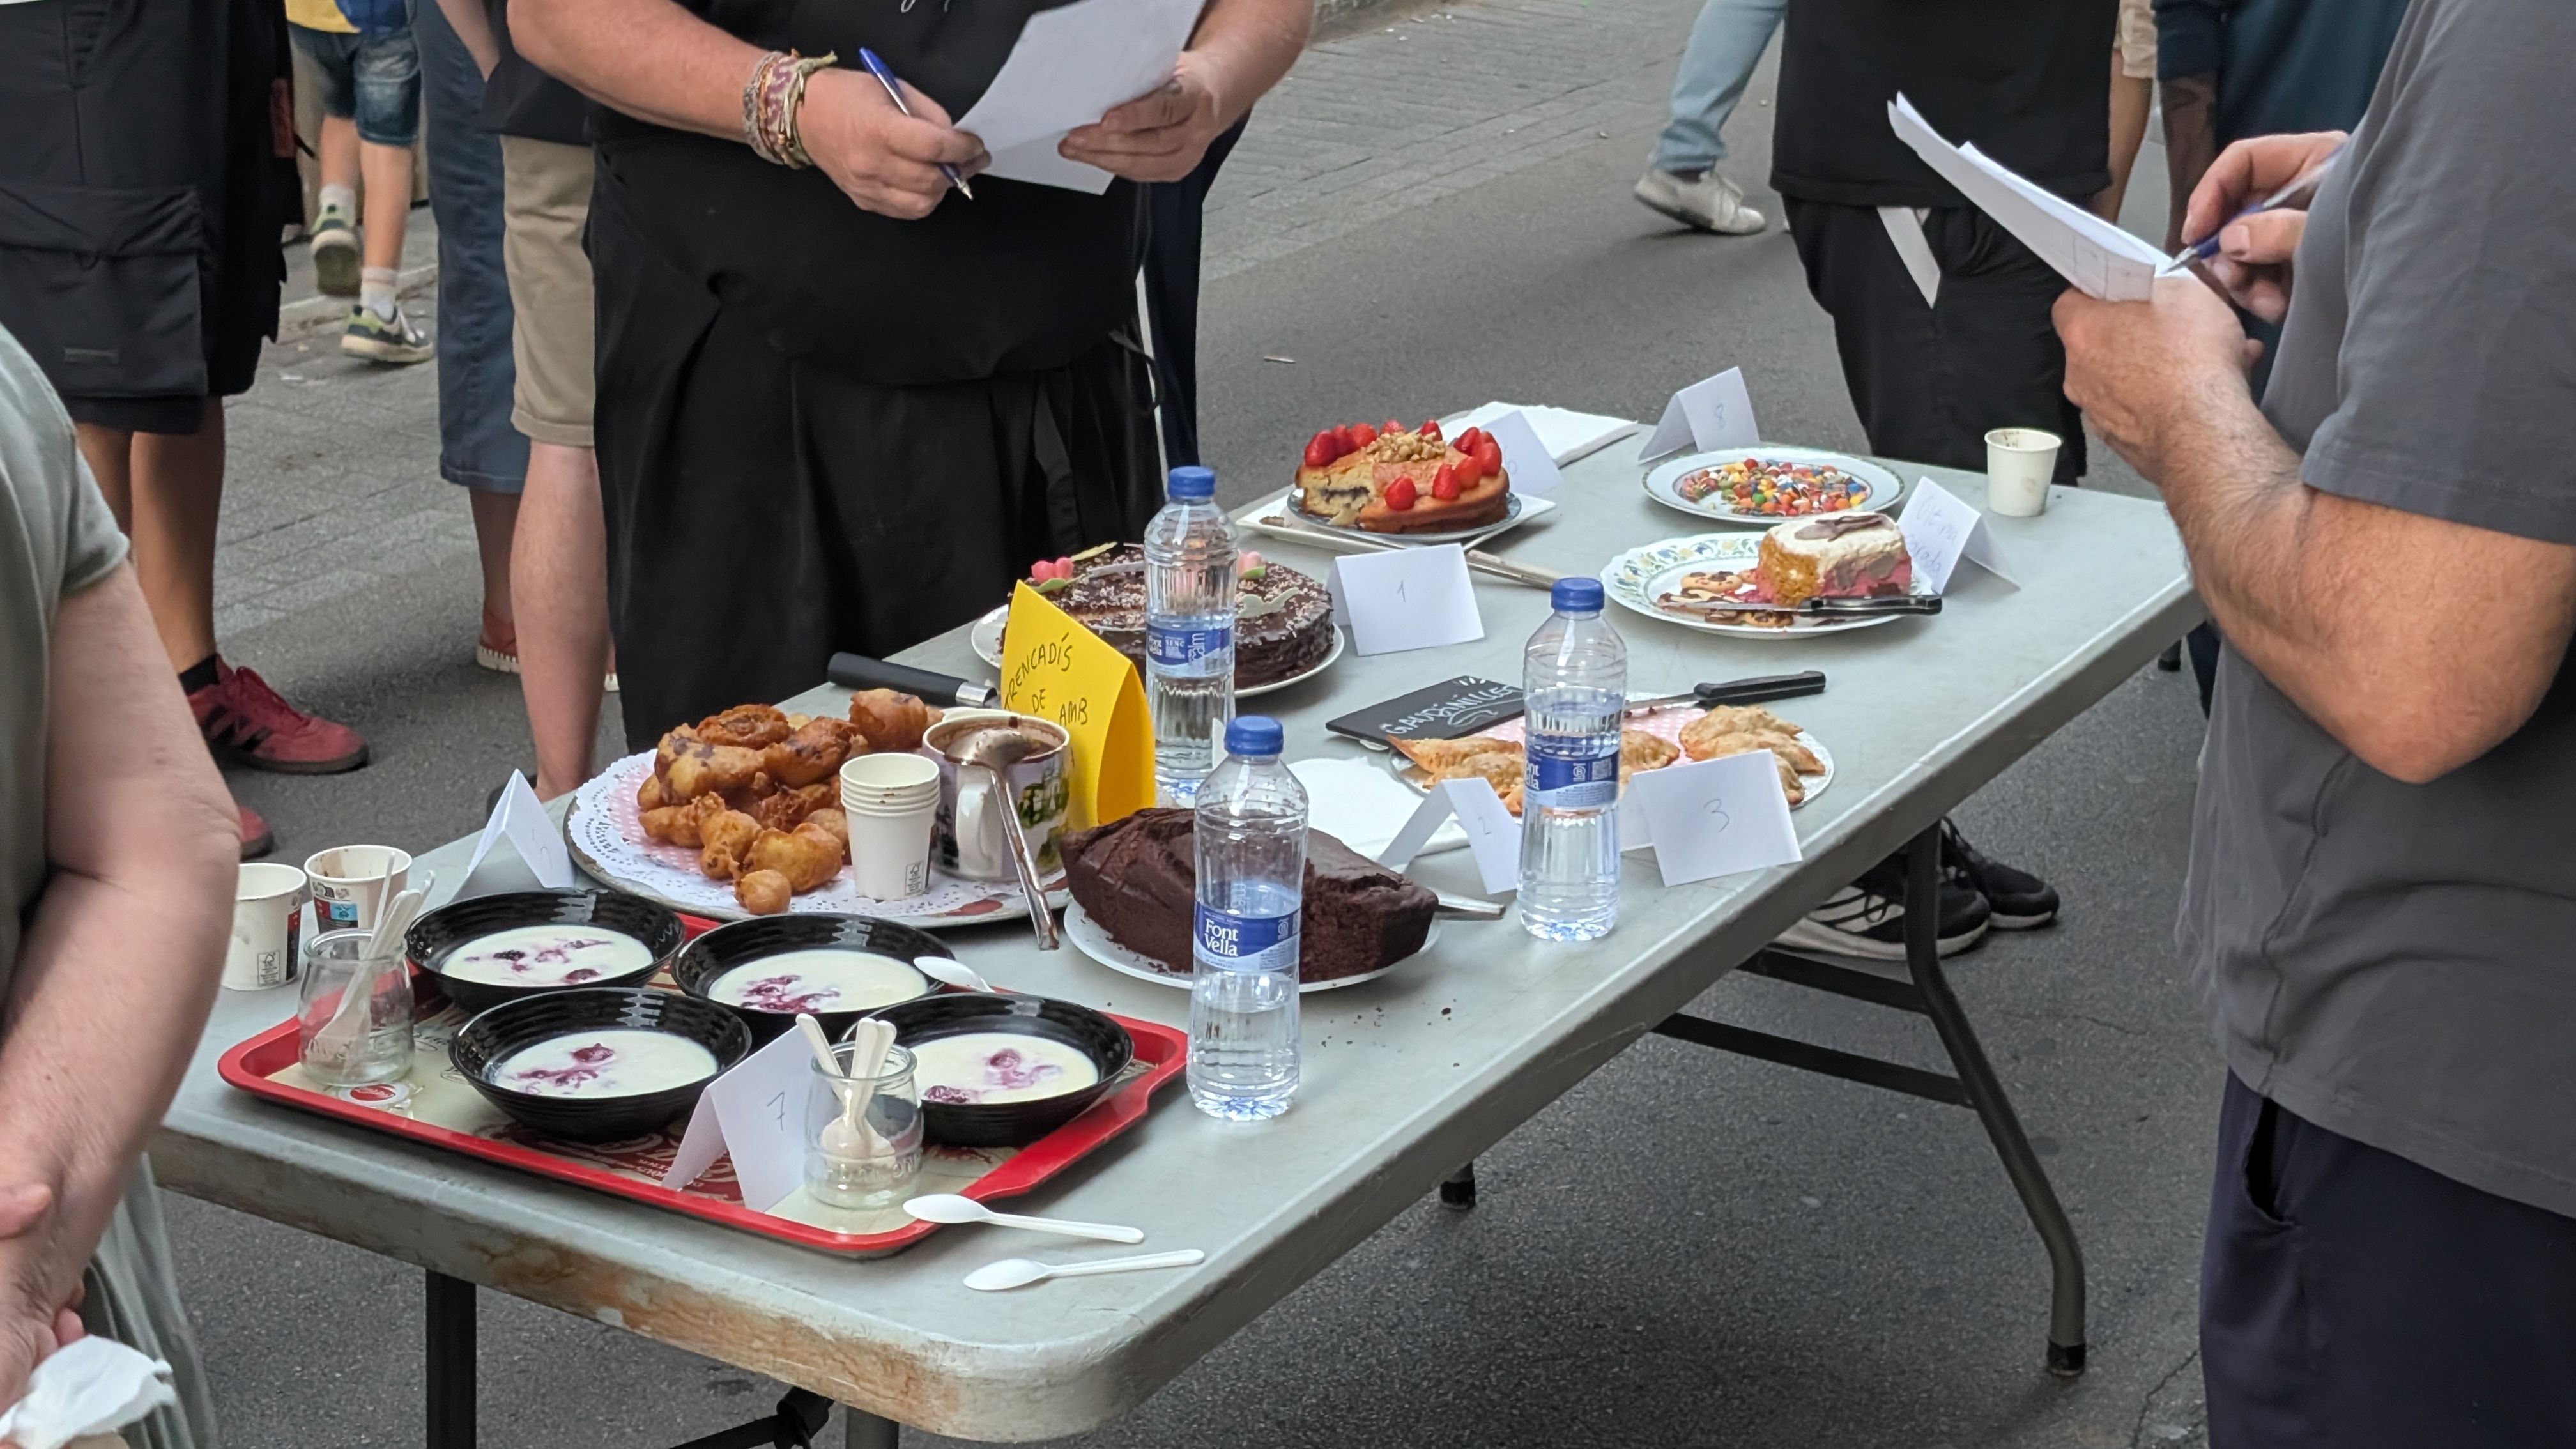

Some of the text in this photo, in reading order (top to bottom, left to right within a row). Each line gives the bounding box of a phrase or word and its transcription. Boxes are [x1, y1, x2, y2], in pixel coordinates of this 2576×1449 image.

[1396, 579, 1406, 603] 1
[1031, 688, 1046, 714] DE
[1059, 697, 1087, 726] AMB
[1703, 798, 1731, 832] 3
[1205, 917, 1239, 942] Font
[1204, 933, 1239, 957] Vella
[767, 1091, 786, 1131] 7
